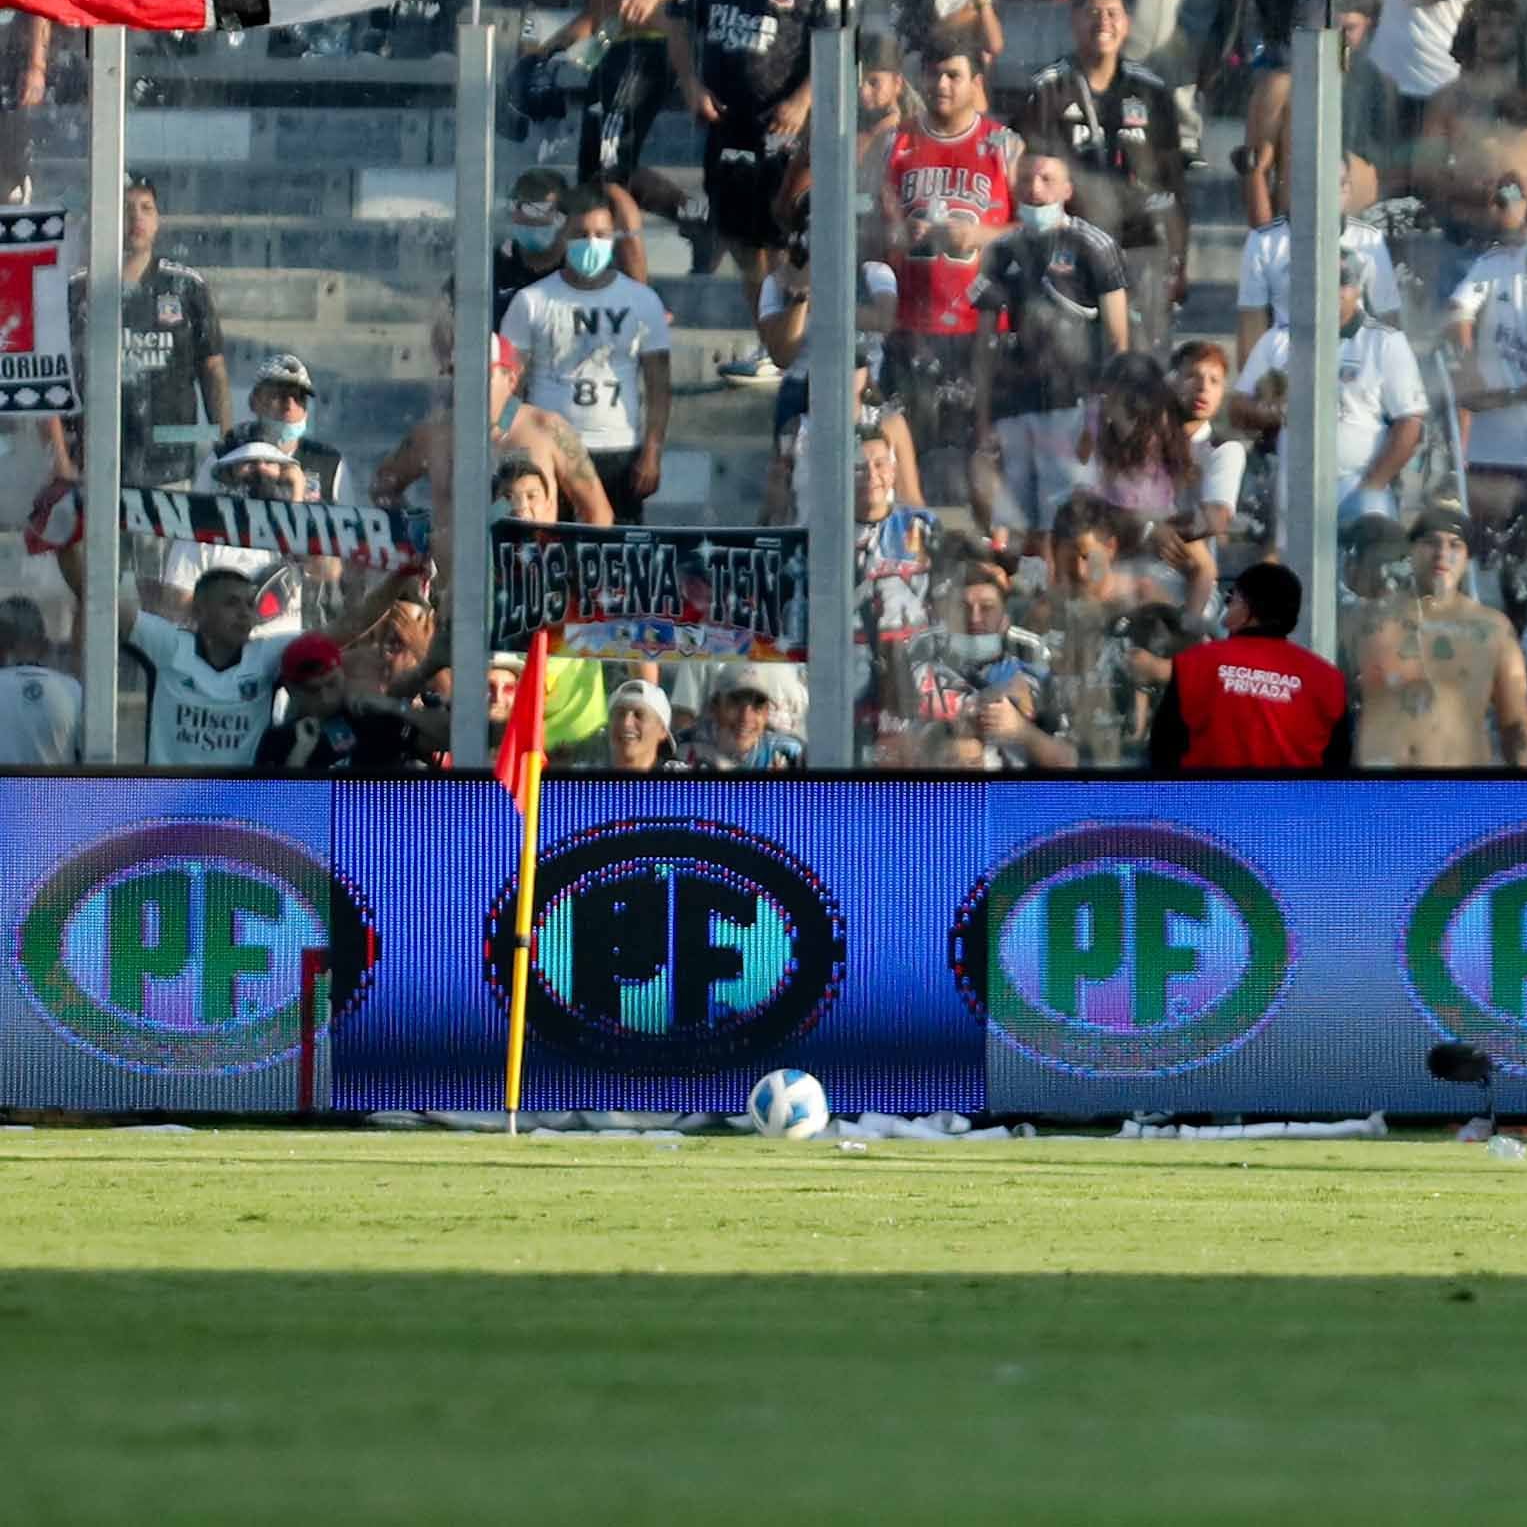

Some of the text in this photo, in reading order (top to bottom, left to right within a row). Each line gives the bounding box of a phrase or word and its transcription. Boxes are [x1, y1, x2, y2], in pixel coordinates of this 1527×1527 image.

[708, 4, 779, 34] Pilsen
[903, 166, 993, 212] BULLS
[573, 307, 630, 336] NY
[122, 327, 173, 349] lsen
[573, 379, 622, 408] 87
[213, 496, 410, 571] JAVIER
[499, 541, 571, 641] LOS
[576, 532, 684, 618] PEÑA
[1217, 663, 1302, 690] SEGURIDAD
[1223, 679, 1292, 703] PRIVADA
[176, 704, 250, 733] Pilsen
[176, 730, 242, 753] del Sur
[104, 867, 285, 1028] PF
[1045, 871, 1209, 1027] PF
